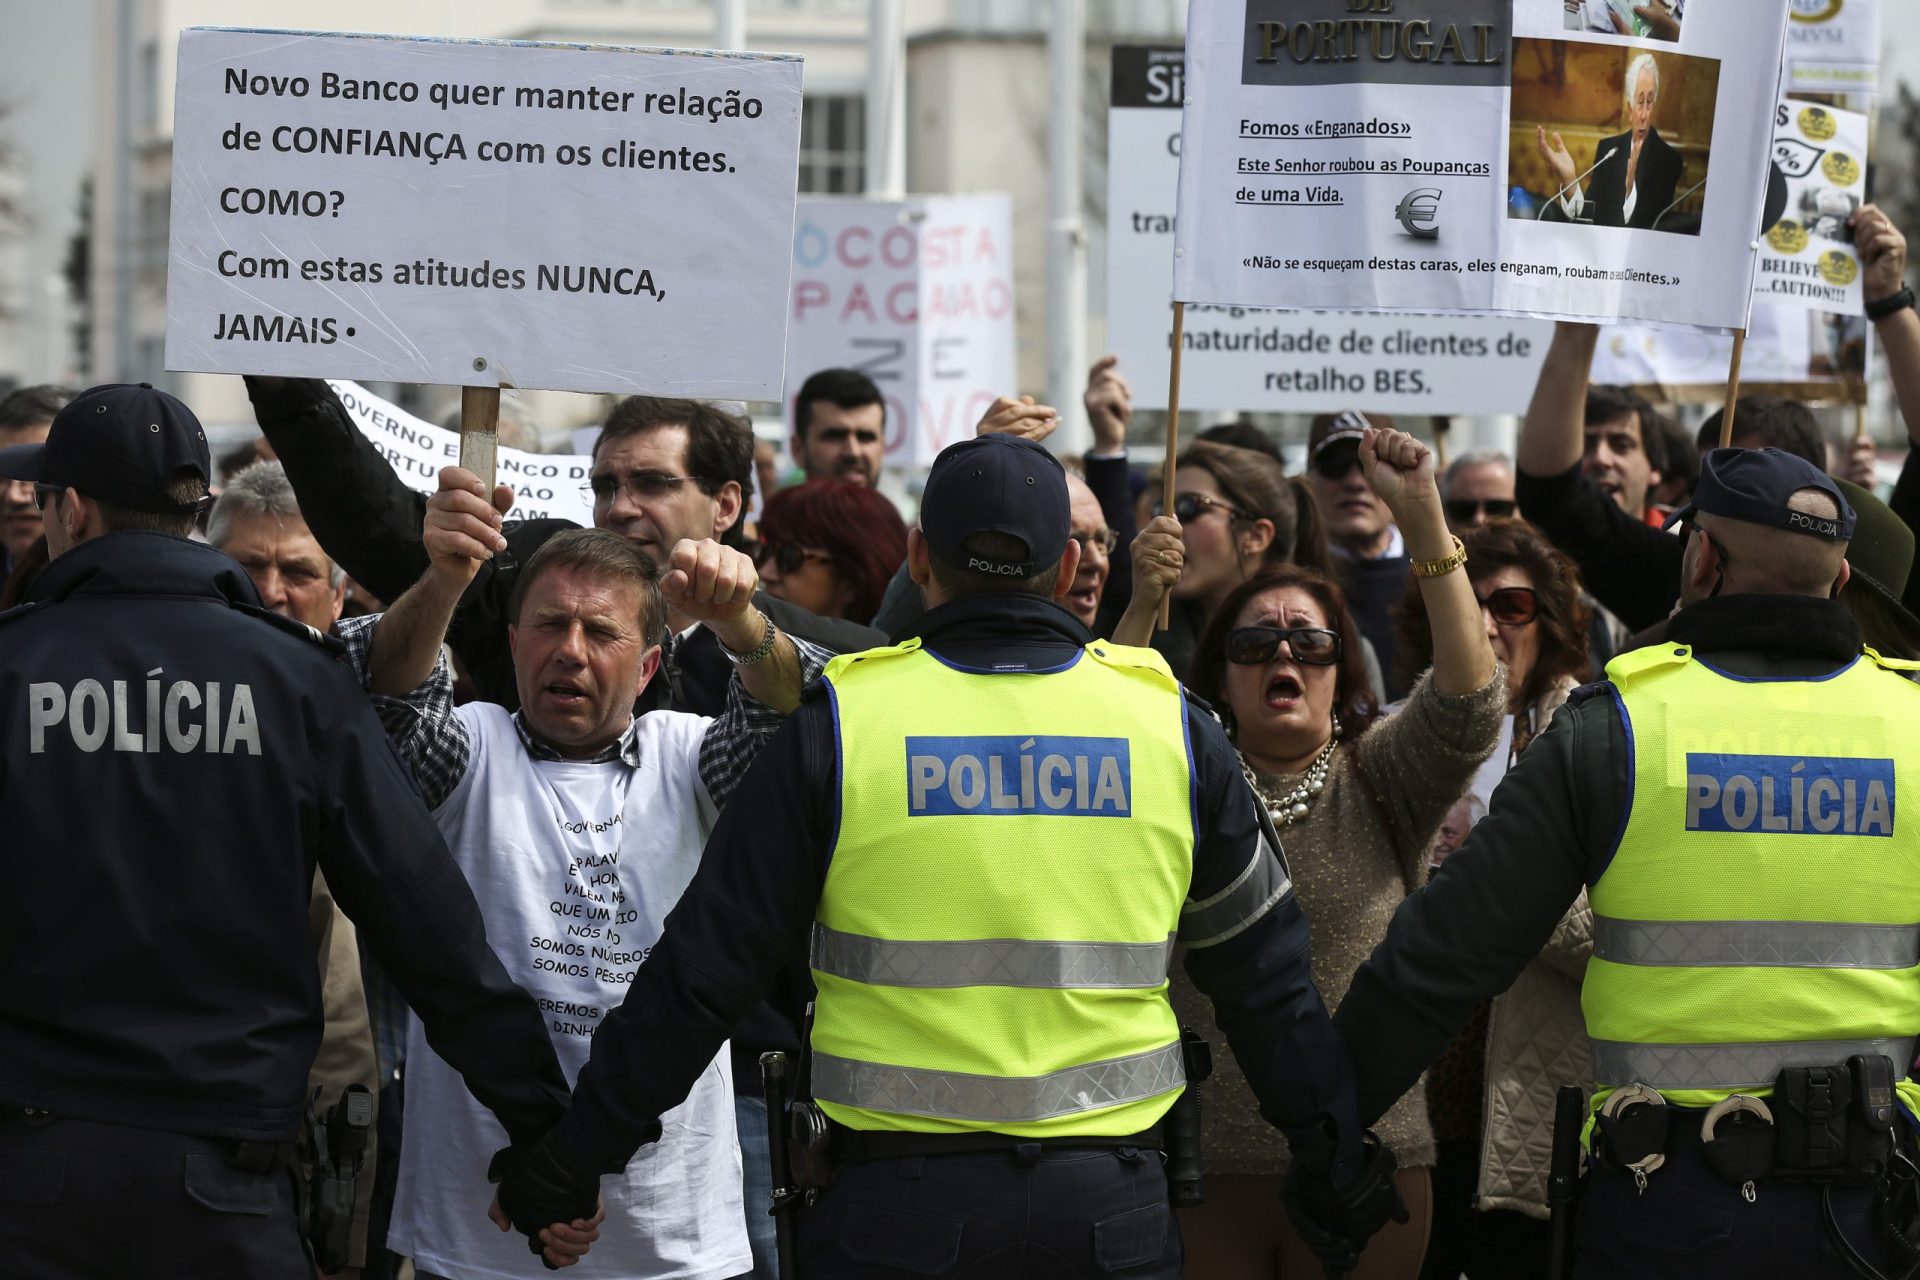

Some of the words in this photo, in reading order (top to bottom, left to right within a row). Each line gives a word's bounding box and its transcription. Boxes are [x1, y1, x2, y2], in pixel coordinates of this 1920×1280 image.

[1256, 19, 1502, 65] PORTUGAL
[224, 67, 310, 98] Novo
[321, 72, 419, 103] Banco
[429, 83, 505, 111] quer
[515, 86, 635, 112] manter
[644, 86, 763, 124] relação
[1145, 64, 1184, 103] Si
[1240, 119, 1300, 136] Fomos
[1304, 118, 1411, 138] «Enganados»
[222, 122, 262, 151] de
[272, 125, 467, 166] CONFIANÇA
[477, 141, 545, 164] com
[556, 144, 592, 166] os
[601, 139, 736, 174] clientes.
[1238, 157, 1270, 172] Este
[1274, 158, 1327, 172] Senhor
[1329, 157, 1375, 172] roubou
[1380, 158, 1398, 171] as
[1402, 158, 1490, 175] Poupanças
[220, 187, 345, 218] COMO?
[1236, 187, 1256, 201] de
[1261, 188, 1300, 202] uma
[1305, 186, 1344, 202] Vida.
[1132, 212, 1176, 234] tra
[217, 250, 289, 279] Com
[300, 257, 383, 284] estas
[393, 258, 526, 290] atitudes
[537, 264, 666, 302] NUNCA,
[1243, 256, 1281, 269] «Não
[1284, 260, 1299, 270] se
[1303, 257, 1364, 273] esqueçam
[1368, 256, 1416, 271] destas
[1420, 261, 1463, 274] caras,
[1467, 258, 1496, 273] eles
[1500, 261, 1562, 278] enganam,
[1565, 265, 1608, 280] roubam
[1624, 268, 1680, 286] Clientes.»
[213, 313, 338, 345] JAMAIS
[1168, 326, 1331, 354] maturidade
[1340, 328, 1374, 355] de
[1382, 328, 1488, 356] clientes
[1496, 330, 1531, 358] de
[1264, 366, 1365, 393] retalho
[1374, 368, 1431, 394] BES.
[443, 443, 459, 458] E
[497, 459, 558, 478] NCO
[28, 666, 263, 756] POLÍCIA
[910, 737, 1129, 812] POLÍCIA
[1686, 760, 1893, 835] POLÍCIA
[564, 882, 606, 904] VALEM
[550, 901, 582, 917] QUE
[586, 907, 611, 921] UM
[567, 923, 601, 939] NÓS
[530, 936, 585, 957] SOMOS
[532, 957, 590, 978] SOMOS
[537, 998, 599, 1019] EREMOS
[553, 1020, 595, 1038] DINH
